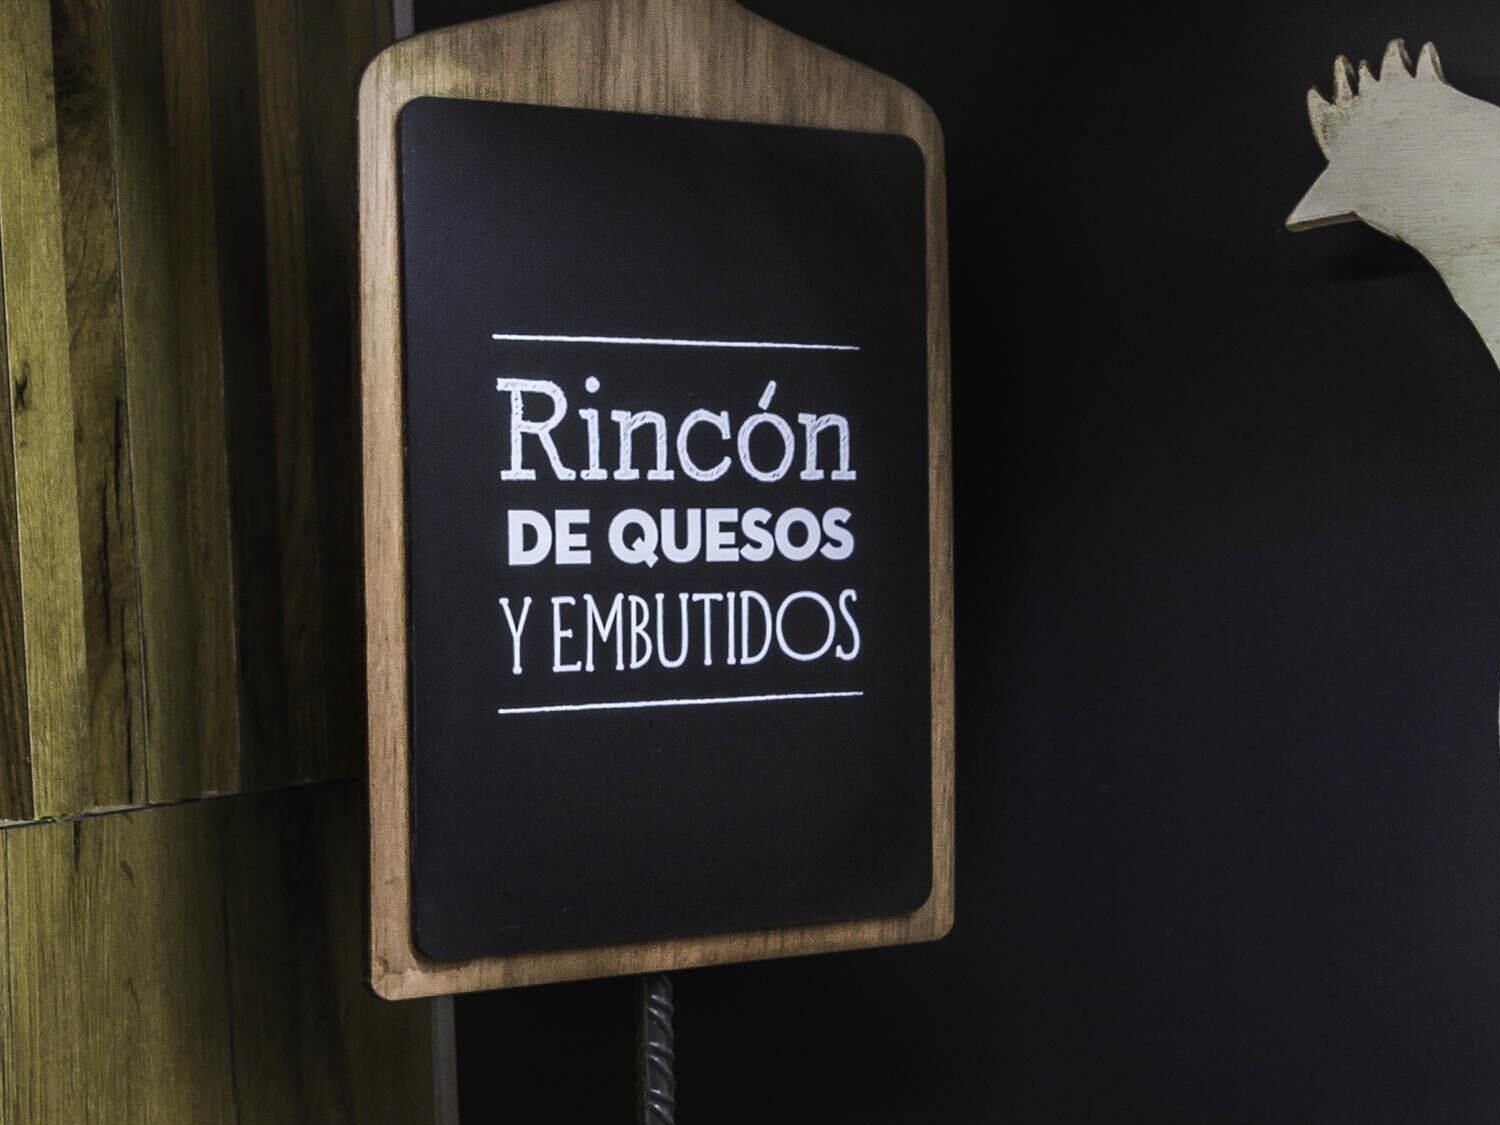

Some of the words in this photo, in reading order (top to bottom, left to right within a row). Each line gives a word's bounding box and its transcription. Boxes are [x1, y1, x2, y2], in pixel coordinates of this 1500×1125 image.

[495, 376, 857, 483] Rincón
[508, 508, 592, 566] DE
[608, 507, 855, 568] QUESOS
[499, 596, 533, 674] Y
[551, 589, 861, 673] EMBUTIDOS
